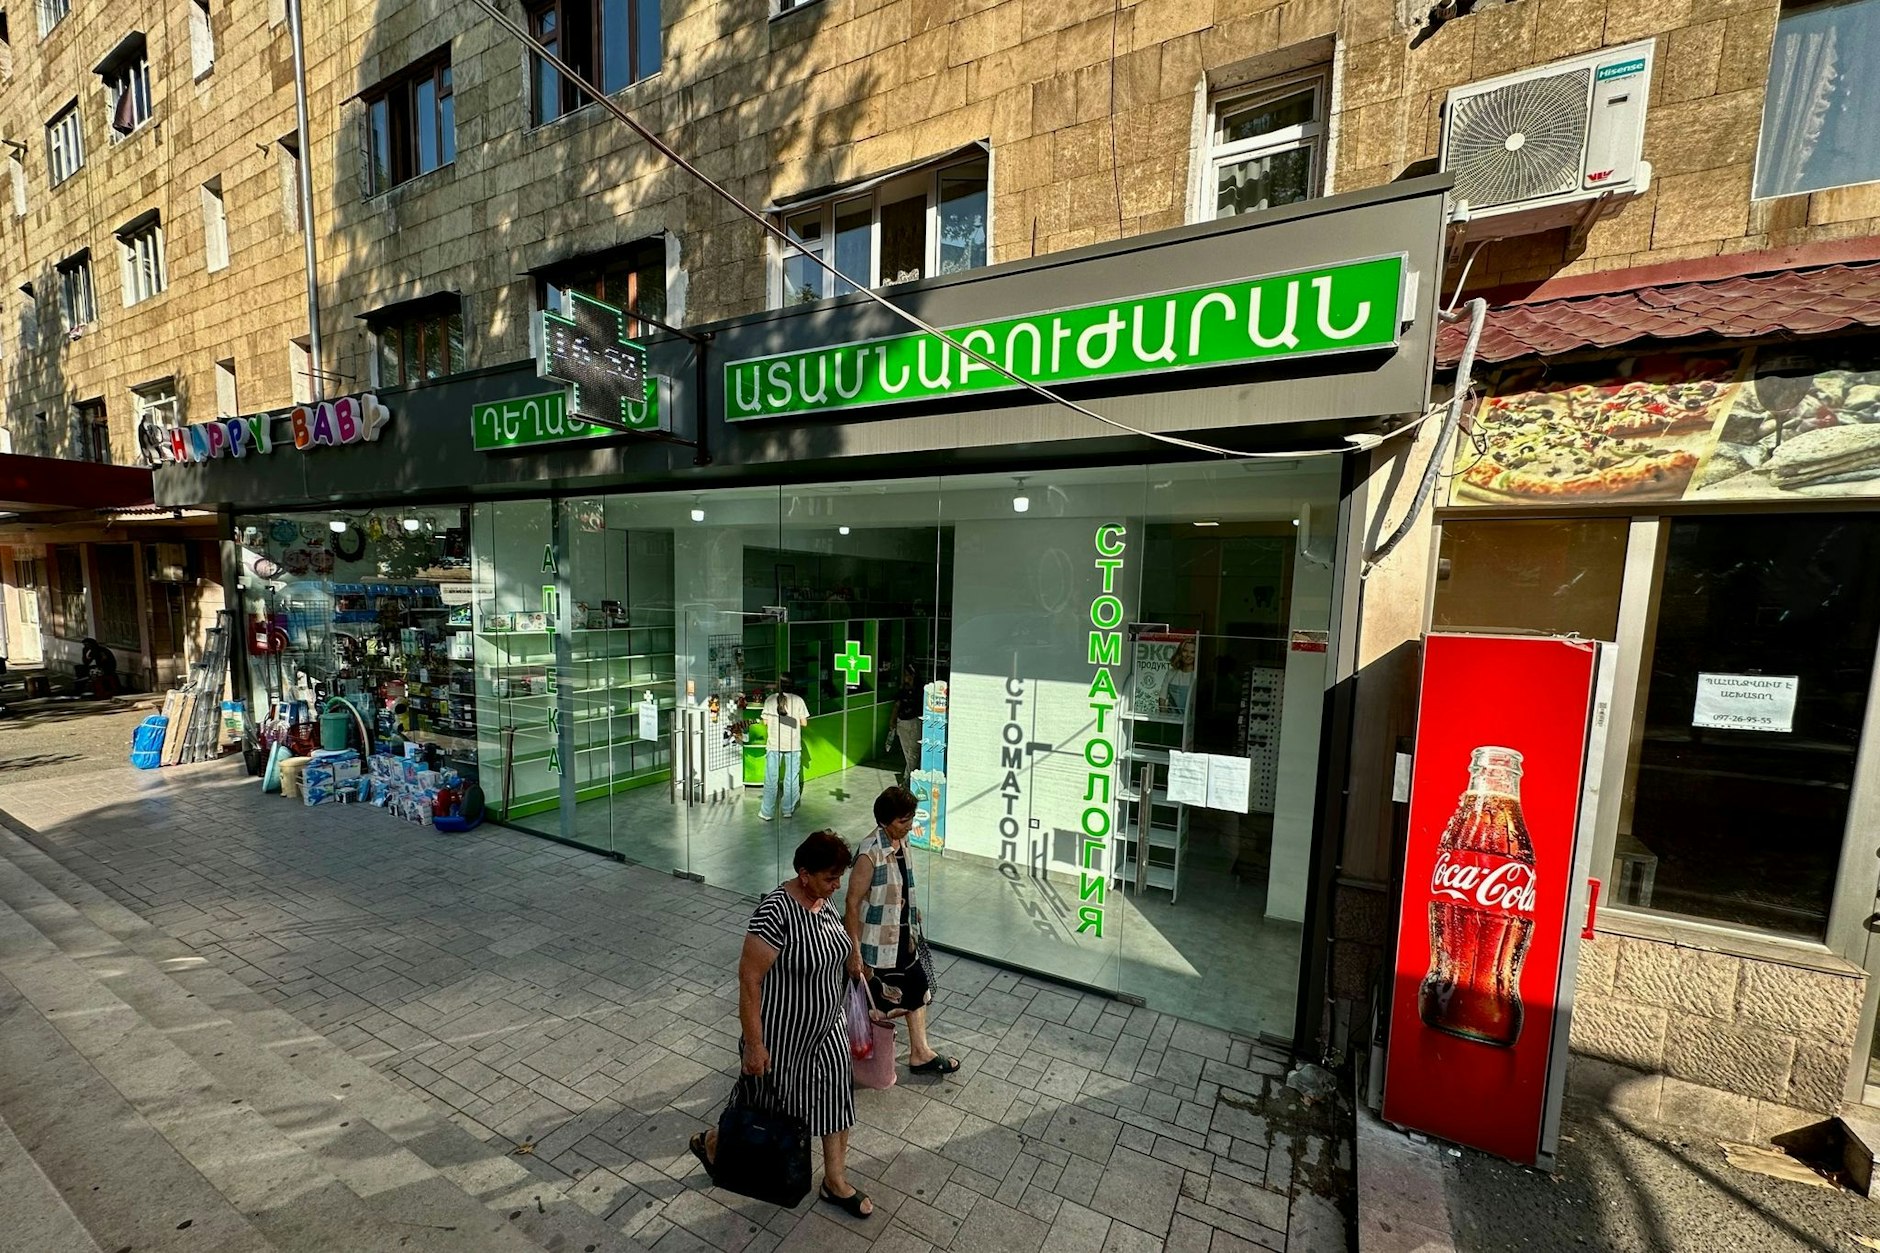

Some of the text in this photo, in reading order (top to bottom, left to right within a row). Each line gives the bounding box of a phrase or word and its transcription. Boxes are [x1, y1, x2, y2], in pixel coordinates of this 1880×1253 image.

[1598, 62, 1644, 77] Hisense
[734, 275, 1373, 414] ԱՏԱՄՆԱԲՈՒԺԱՐԱՆ
[170, 393, 390, 463] HAPPY BABY
[541, 543, 562, 776] АПТЕКА
[1075, 522, 1127, 938] СТОМАТОЛОГИЯ
[1712, 714, 1772, 724] 097-26-95-55
[1430, 852, 1537, 912] Coca-Cola
